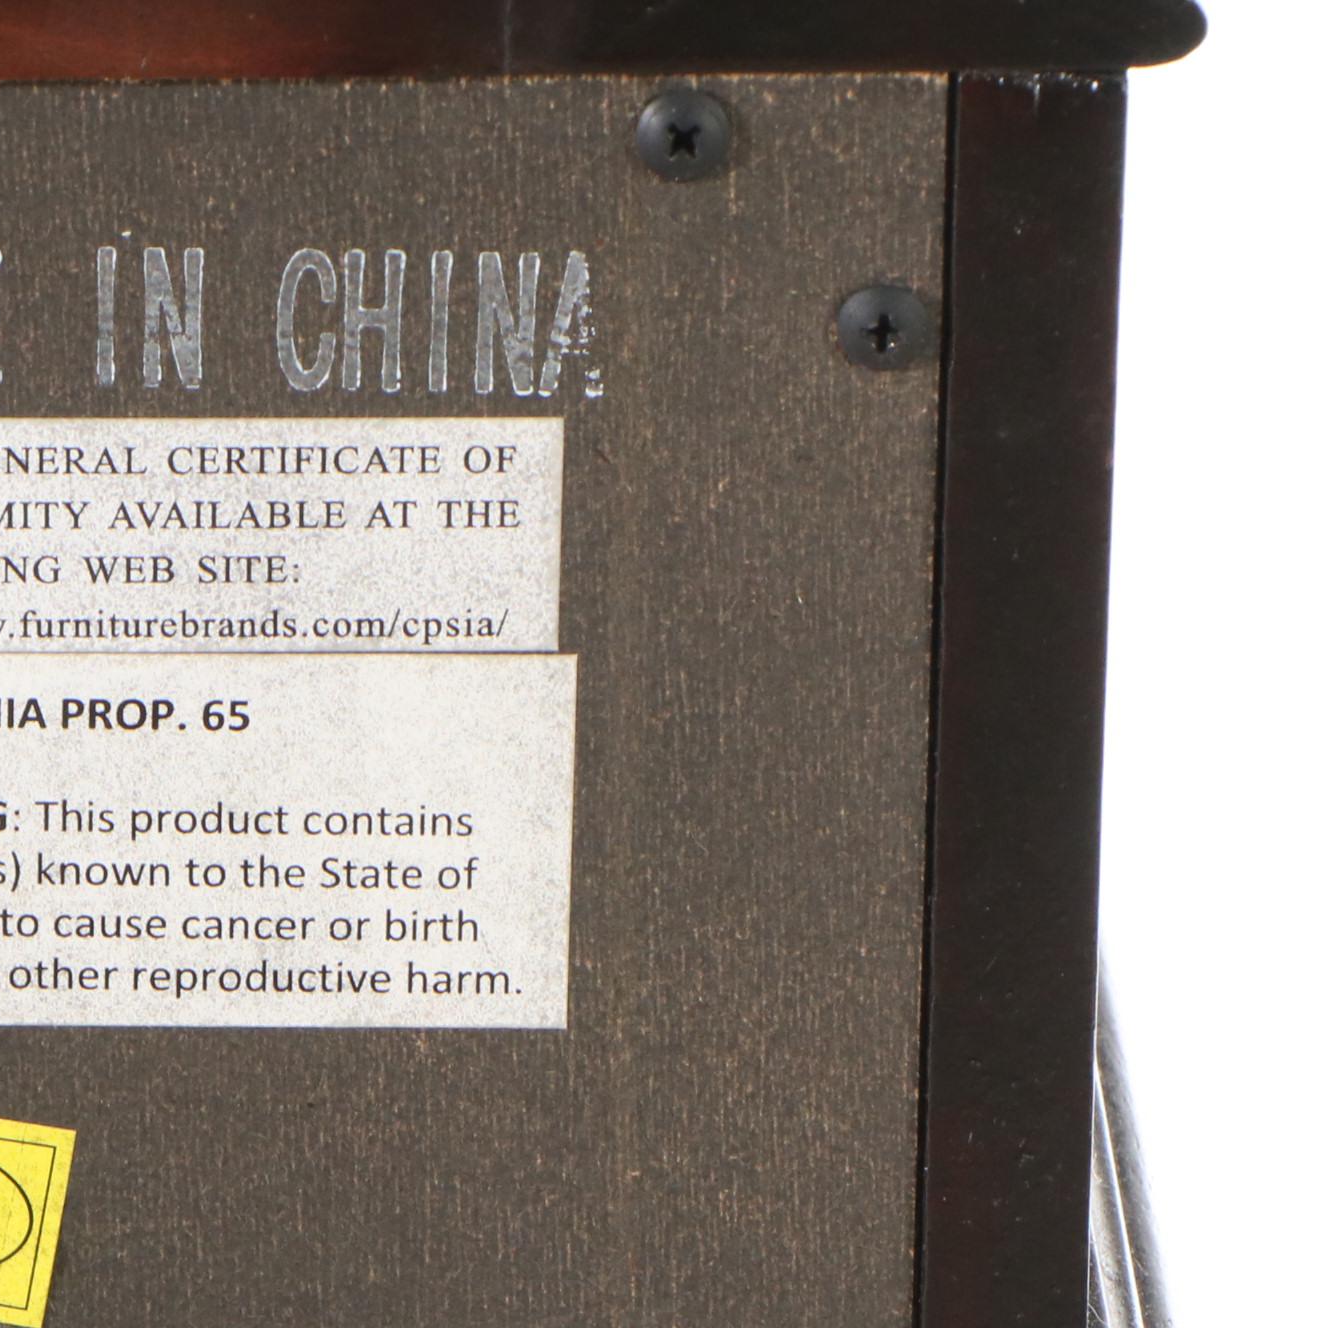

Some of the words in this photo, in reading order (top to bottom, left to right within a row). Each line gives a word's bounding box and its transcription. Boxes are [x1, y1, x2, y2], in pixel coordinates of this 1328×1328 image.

[96, 246, 204, 389] IN
[276, 247, 604, 398] CHINA
[167, 445, 442, 477] CERTIFICATE
[463, 445, 519, 477] OF
[109, 500, 348, 530] AVAILABLE
[365, 500, 417, 530] AT
[437, 498, 522, 530] THE
[82, 554, 177, 586] WEB
[196, 554, 303, 586] SITE:
[59, 697, 188, 733] PROP.
[201, 699, 251, 733] 65
[35, 799, 117, 835] This
[130, 800, 289, 842] product
[302, 805, 474, 838] contains
[36, 853, 172, 888] known
[184, 857, 227, 890] to
[240, 856, 306, 890] the
[319, 857, 423, 891] State
[437, 855, 480, 891] of
[53, 913, 169, 940] cause
[181, 913, 316, 942] cancer
[329, 915, 372, 943] or
[384, 909, 480, 943] birth
[8, 957, 121, 993] other
[132, 961, 392, 1001] reproductive
[406, 962, 524, 995] harm.
